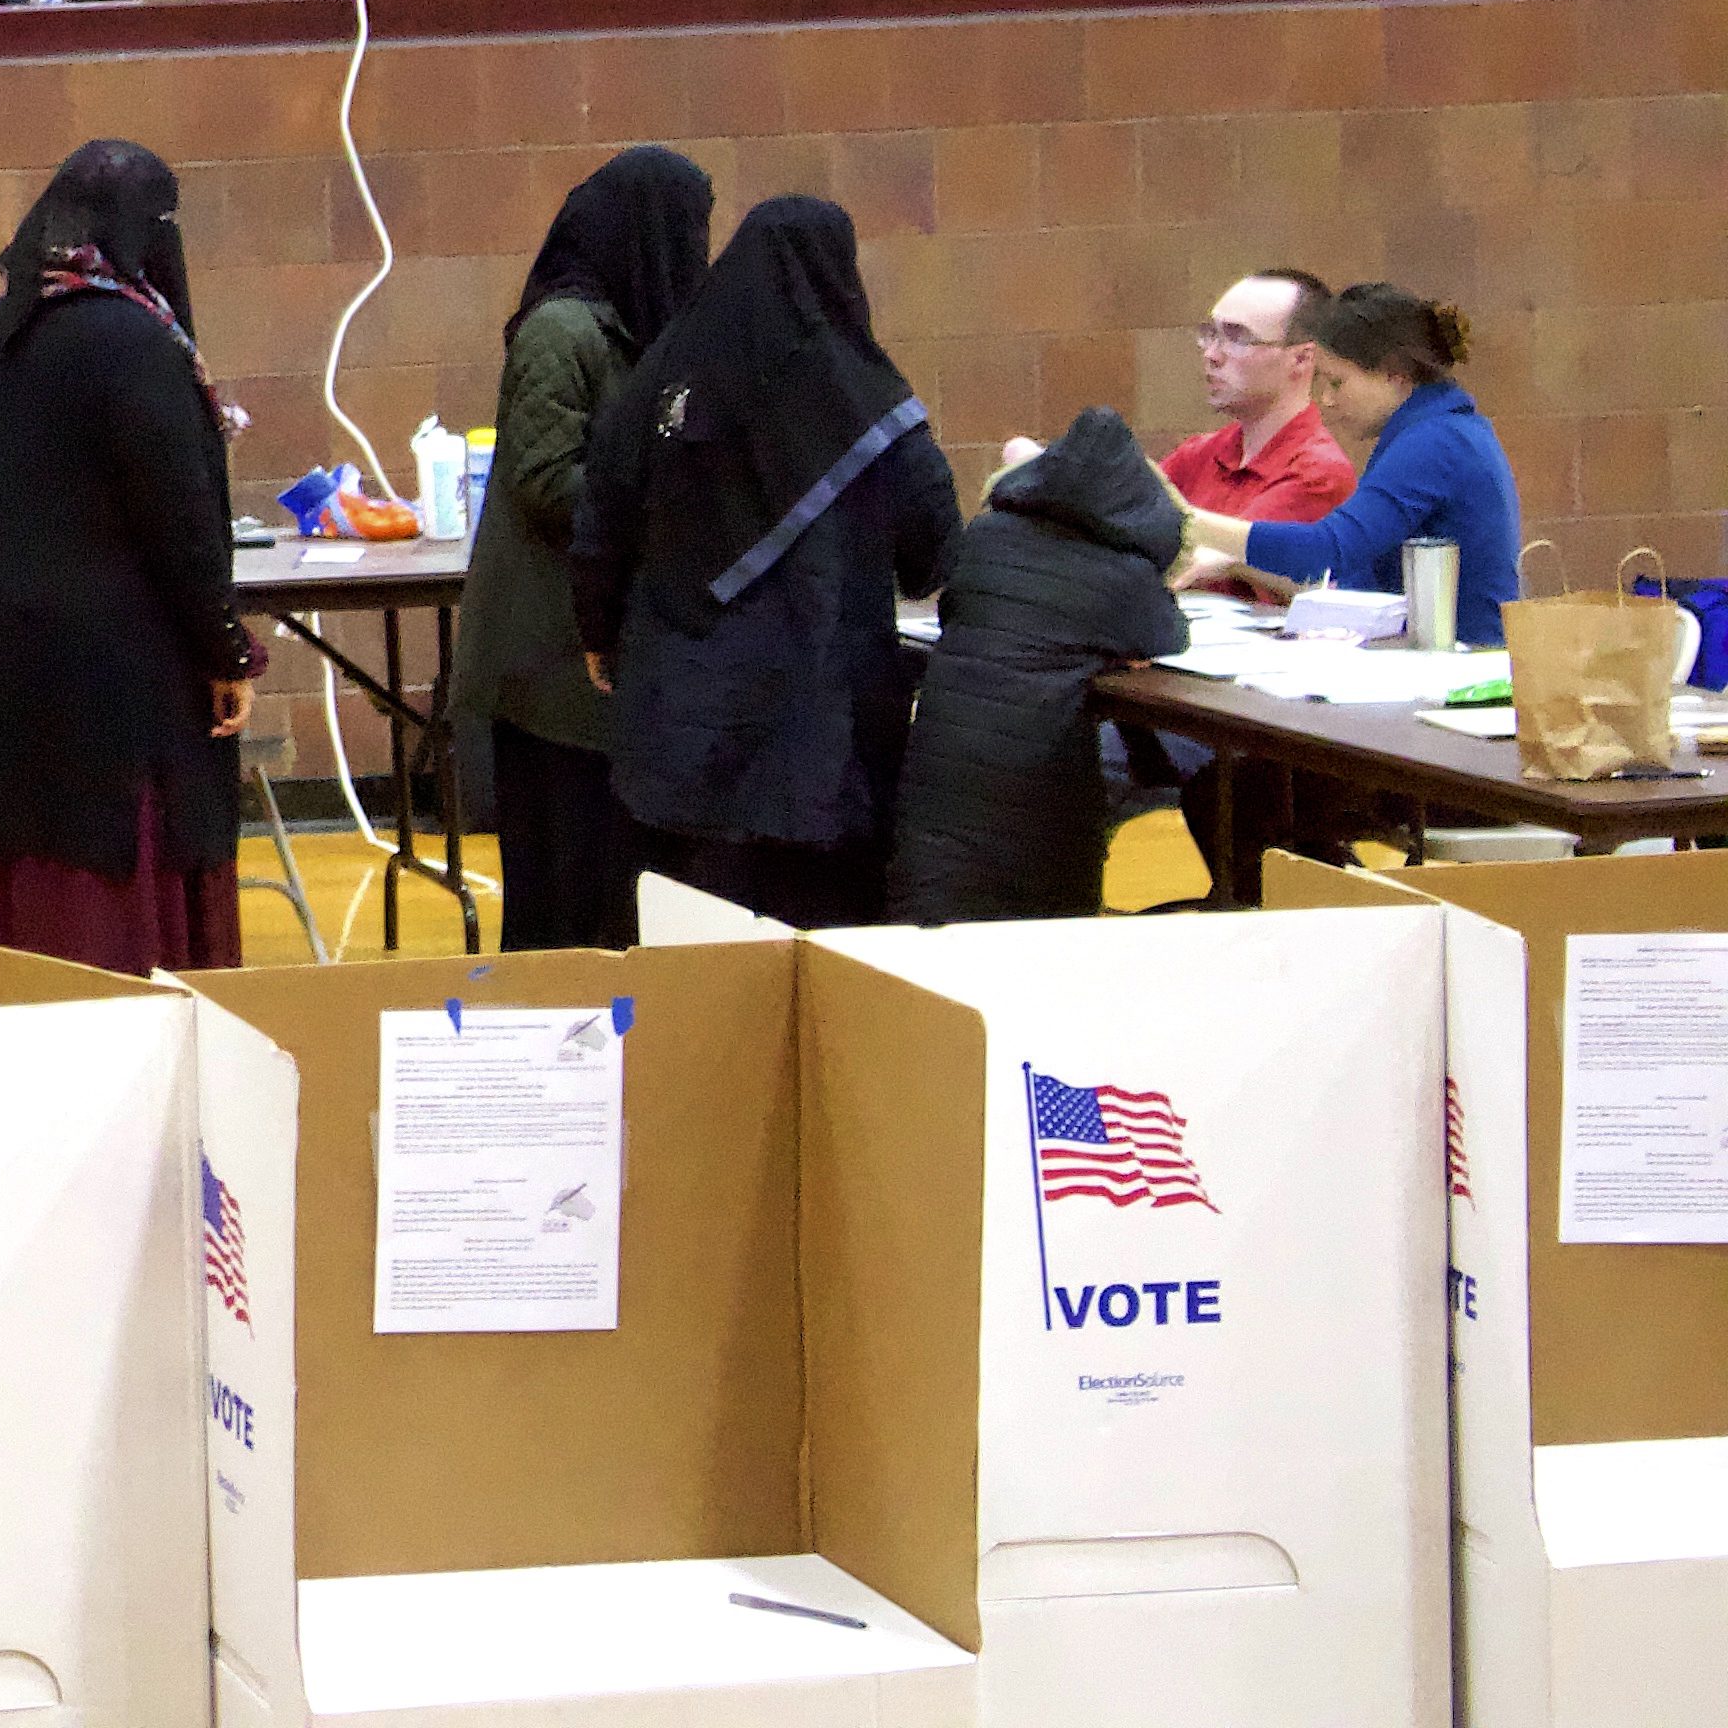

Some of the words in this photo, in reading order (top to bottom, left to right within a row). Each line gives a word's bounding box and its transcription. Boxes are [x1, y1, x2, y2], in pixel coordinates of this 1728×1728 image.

[1054, 1280, 1221, 1329] VOTE
[1448, 1265, 1478, 1321] TE
[1078, 1371, 1185, 1391] ElectionSource
[208, 1373, 254, 1451] VOTE
